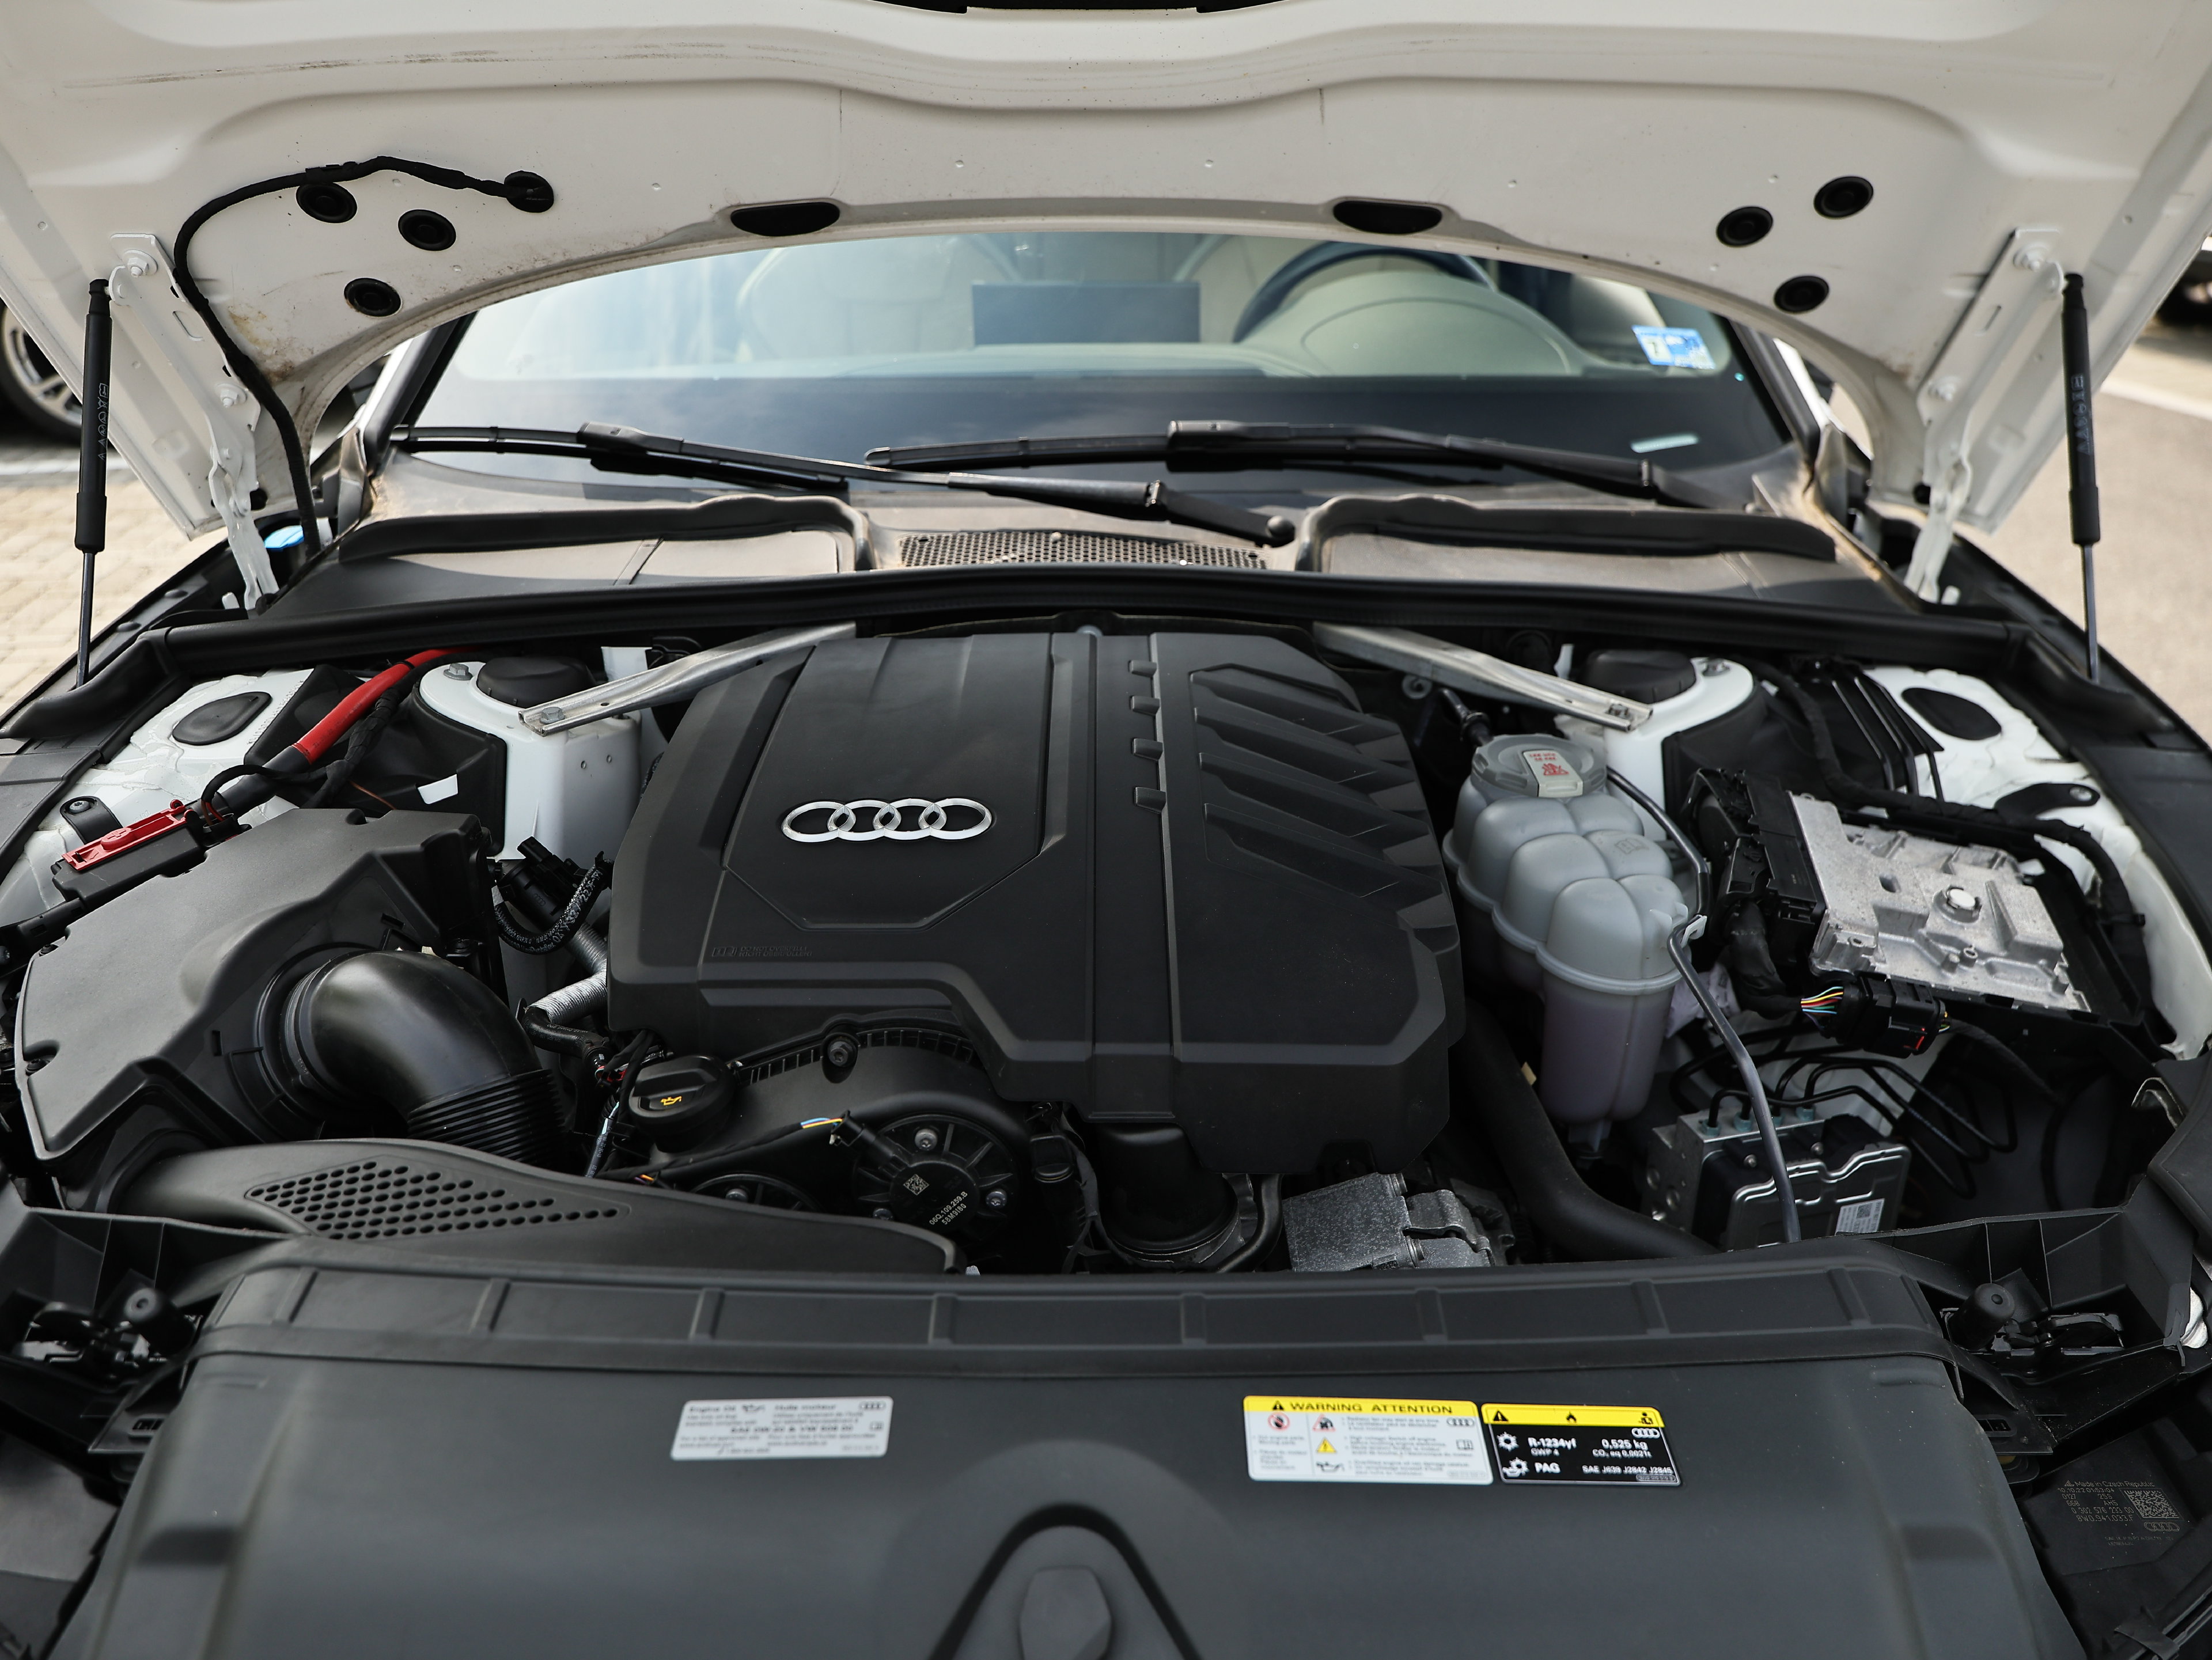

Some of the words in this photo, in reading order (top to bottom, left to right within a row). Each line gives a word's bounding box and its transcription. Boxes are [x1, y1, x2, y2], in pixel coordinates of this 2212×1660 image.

[929, 1191, 968, 1225] 06Q.109.259.B
[1290, 1403, 1362, 1412] WARNING
[1372, 1404, 1452, 1414] ATTENTION
[1528, 1437, 1577, 1450] R-1234yf
[1601, 1438, 1632, 1450] 0,525
[1633, 1439, 1649, 1450] kg
[1534, 1462, 1561, 1473] PAG
[1582, 1465, 1601, 1474] SAE
[1601, 1466, 1623, 1475] J639
[1623, 1466, 1647, 1475] J2842
[1649, 1466, 1674, 1475] J2845
